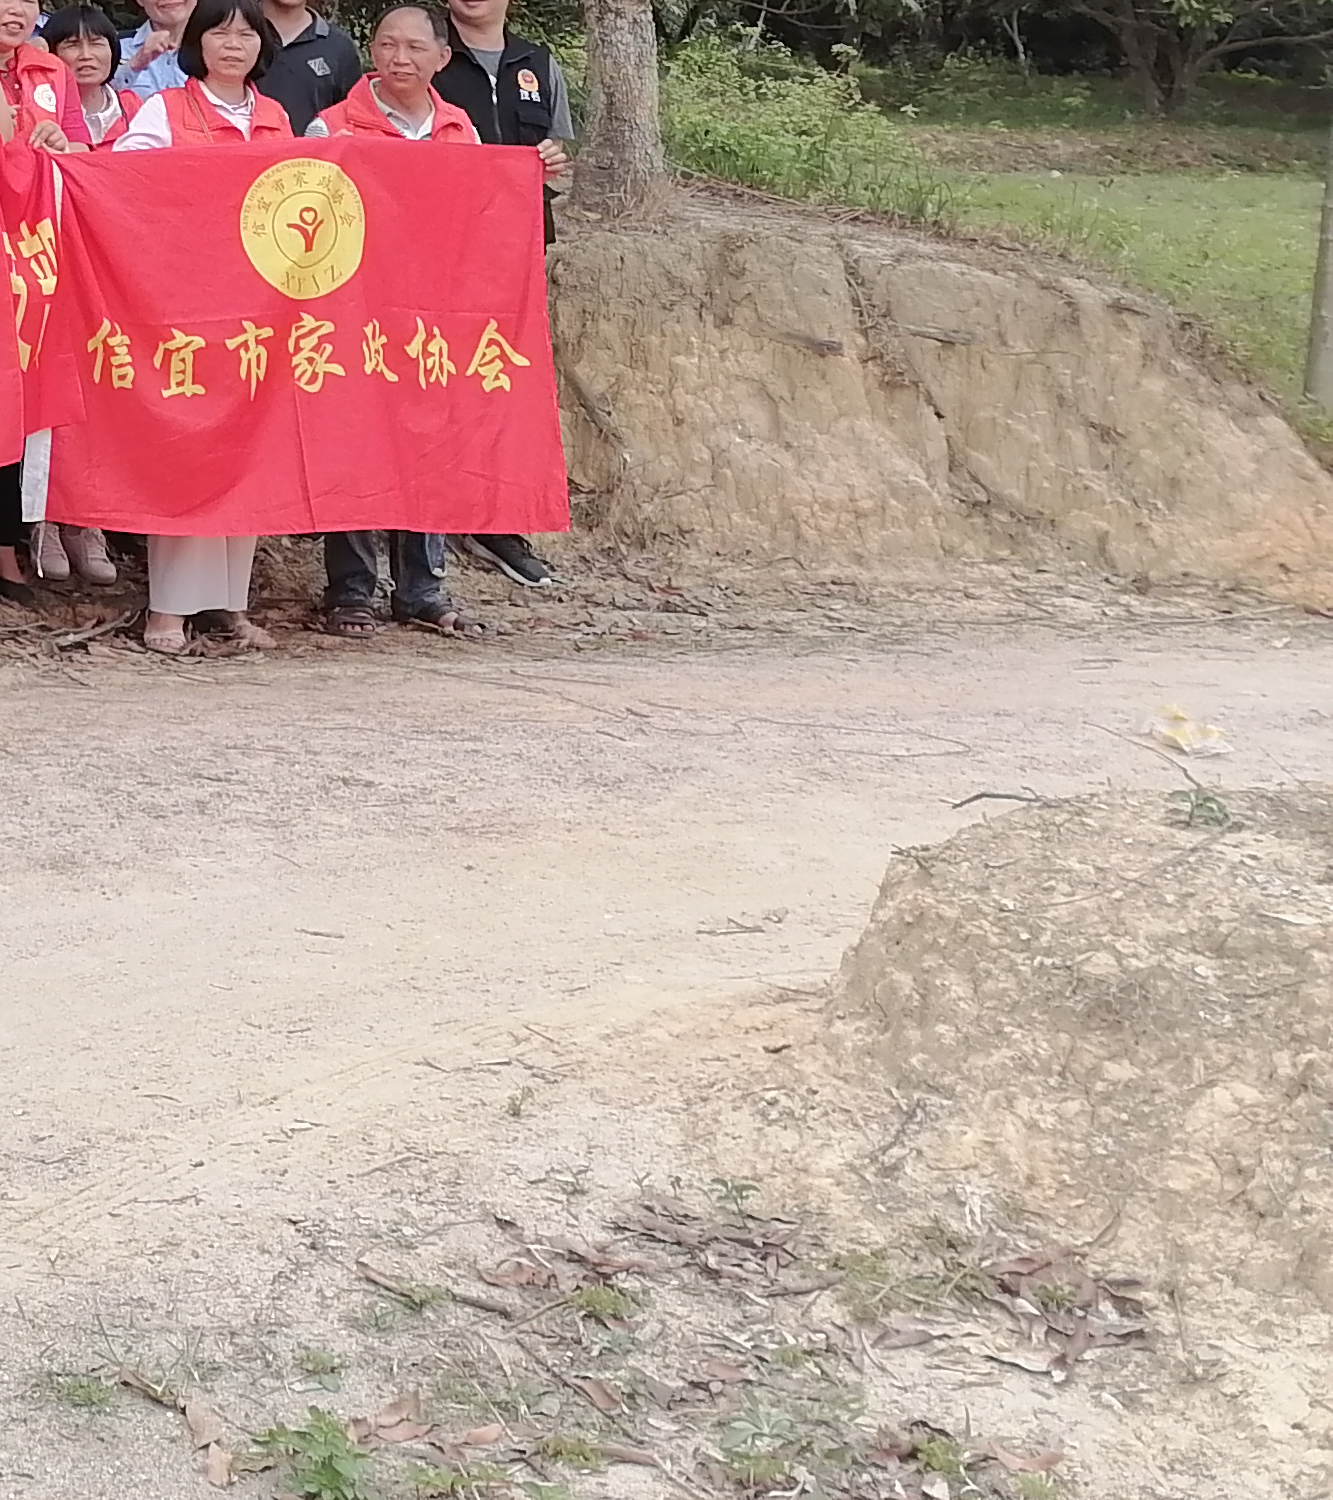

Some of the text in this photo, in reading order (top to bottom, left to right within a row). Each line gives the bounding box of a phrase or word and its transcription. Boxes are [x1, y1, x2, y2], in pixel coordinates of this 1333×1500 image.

[87, 311, 531, 400] 信宜市家政协会
